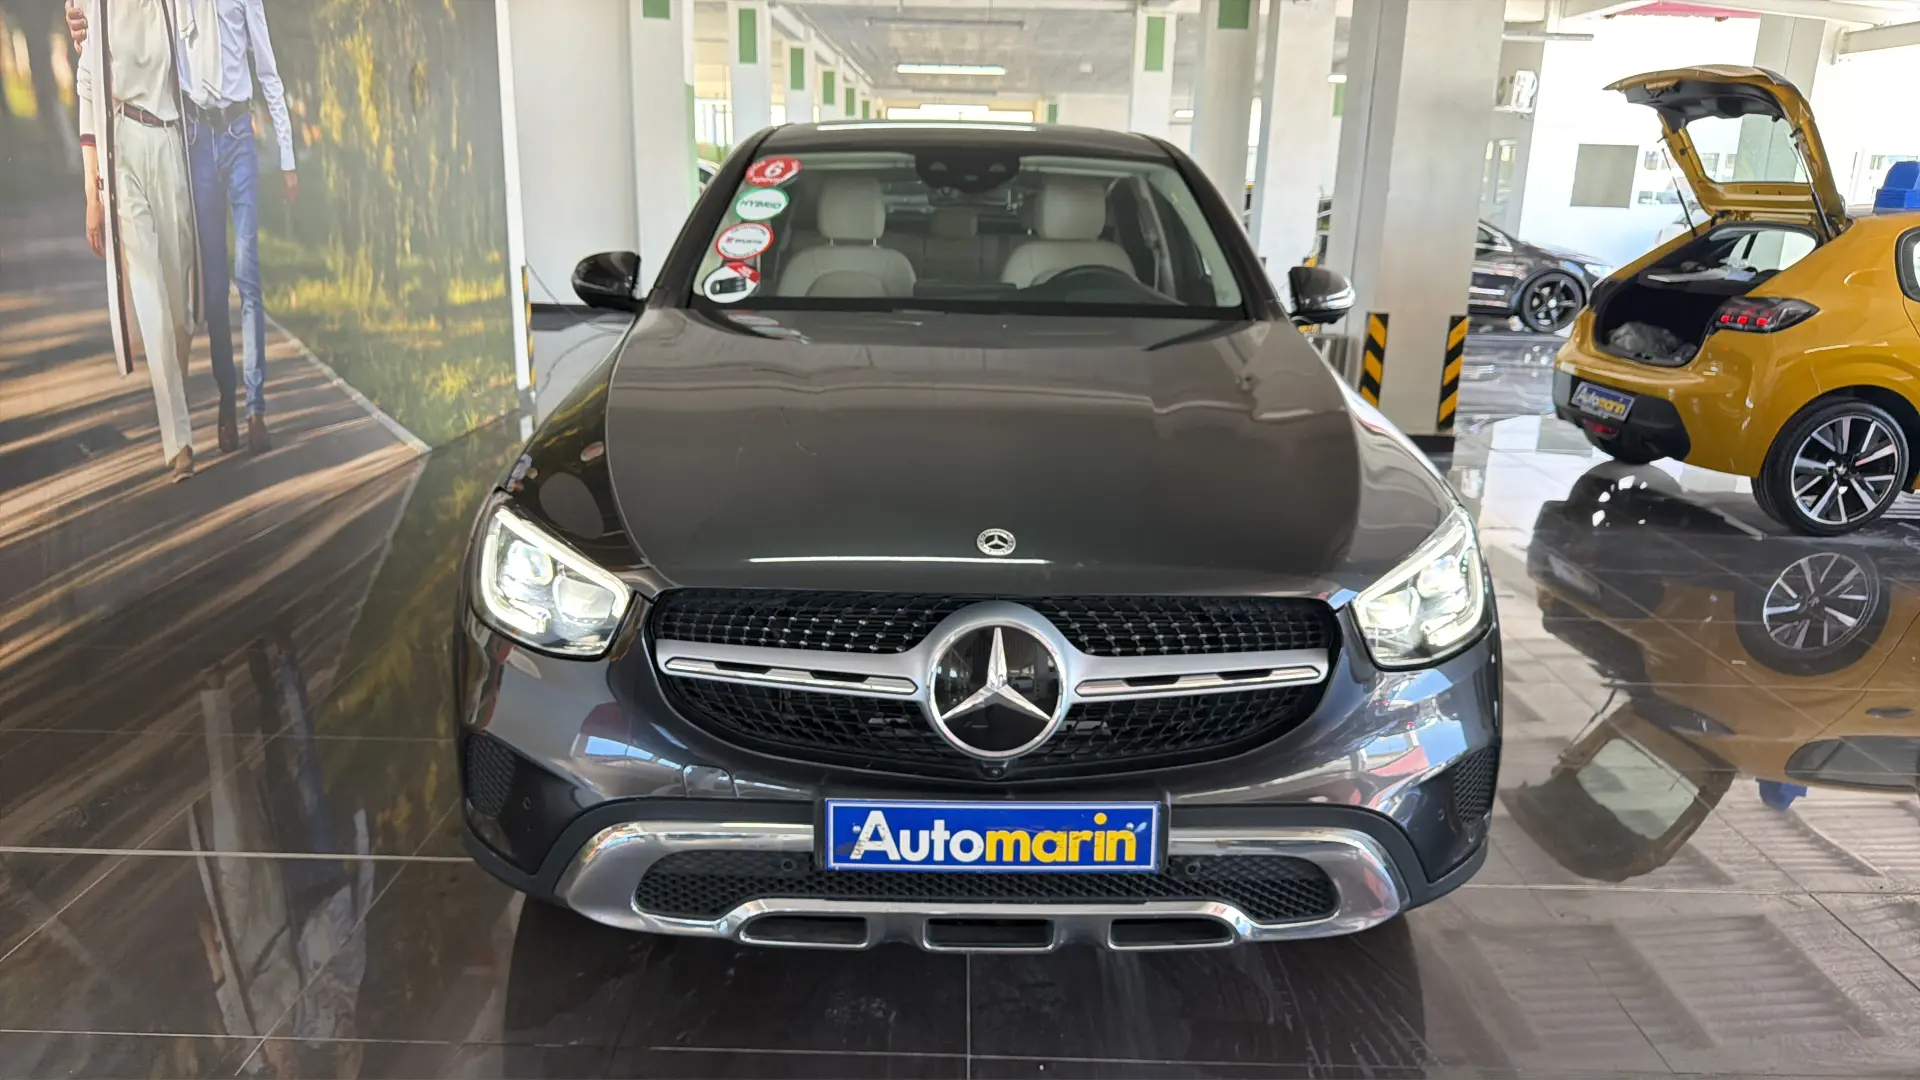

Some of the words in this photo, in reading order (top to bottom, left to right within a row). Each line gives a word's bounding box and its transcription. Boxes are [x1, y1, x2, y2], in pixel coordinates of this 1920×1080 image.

[763, 160, 785, 178] 6
[740, 199, 782, 210] HYBRID
[849, 809, 1137, 863] Automarin
